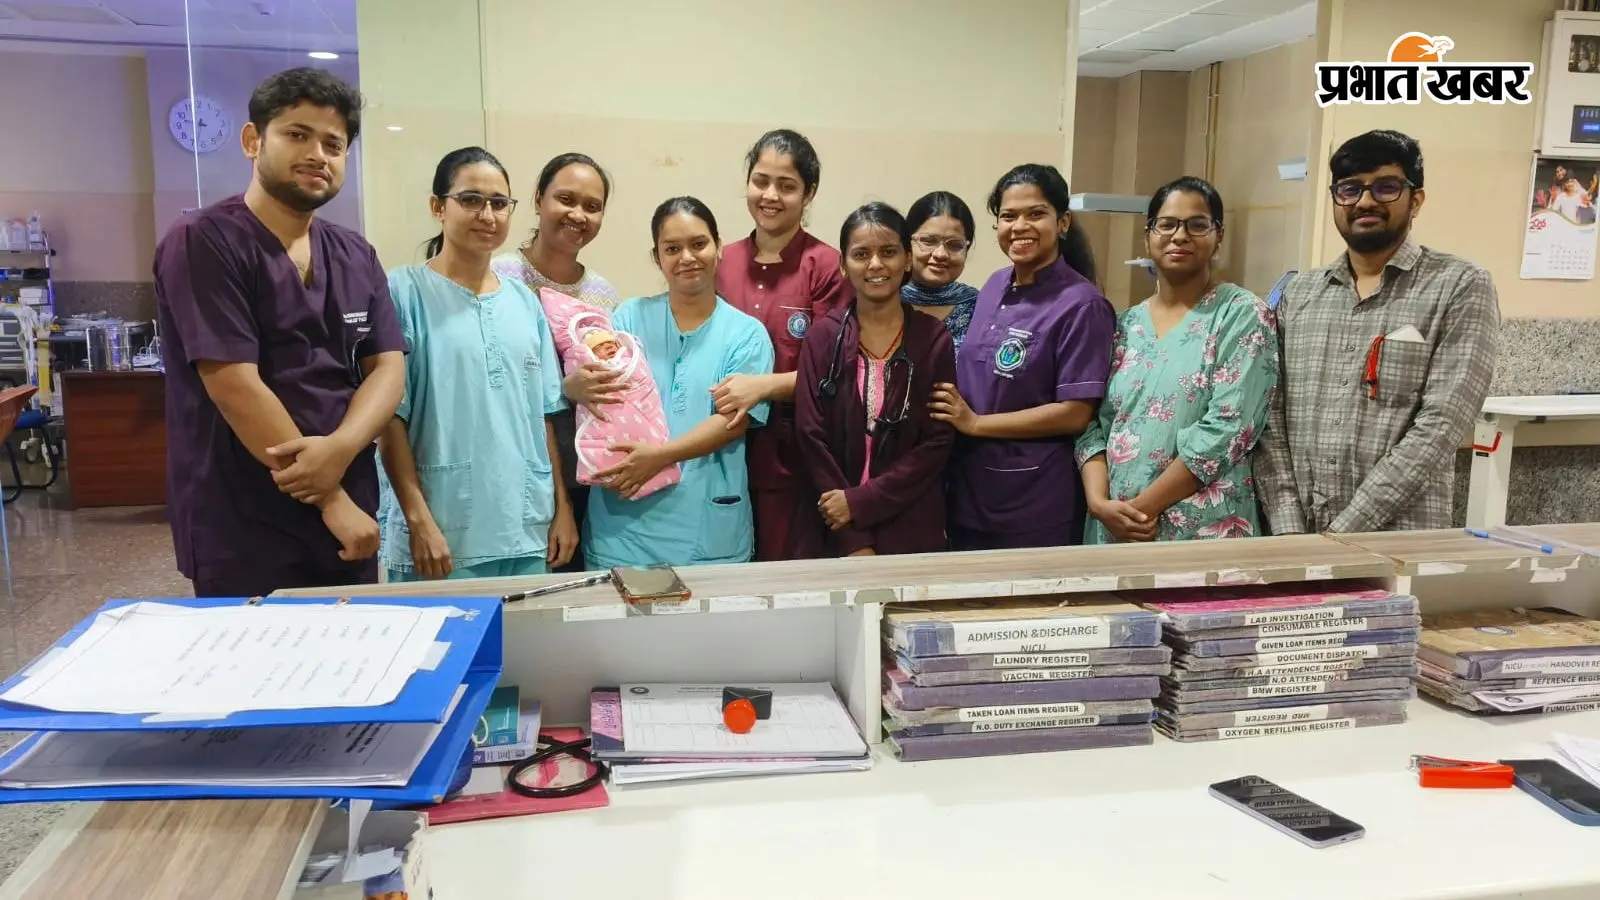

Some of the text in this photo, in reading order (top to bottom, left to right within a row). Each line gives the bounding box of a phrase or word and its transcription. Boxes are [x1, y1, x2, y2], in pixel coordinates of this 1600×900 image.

[1250, 611, 1335, 624] LAB INVESTIGATION
[1262, 616, 1364, 634] CONSUMABLE REGISTER
[968, 625, 1098, 643] ADMISSION &DISCHARGE
[1019, 643, 1046, 653] NICU
[1261, 640, 1284, 650] GIVEN
[1285, 639, 1304, 648] LOAN
[1305, 638, 1327, 647] ITEMS
[994, 655, 1088, 665] LAUNDRY REGISTER
[1277, 649, 1368, 662] DOCUMENT DISPATCH
[1265, 665, 1321, 676] ATTENDENCE
[1505, 661, 1523, 670] NICU
[1550, 660, 1590, 669] HANDOVER
[1003, 669, 1095, 681] VACCINE REGISTER
[1272, 676, 1287, 684] N.O
[1532, 675, 1577, 685] REFERENCE
[1252, 683, 1318, 694] BMW REGISTER
[967, 704, 1080, 718] TAKEN LOAN ITEMS REGISTER
[1545, 703, 1595, 713] FUMIGATION
[994, 721, 1014, 730] DUTY
[1015, 719, 1057, 729] EXCHANGE
[1058, 716, 1096, 726] REGISTER
[1245, 712, 1288, 723] REGISTER
[1225, 720, 1351, 738] OXYGEN REFILLING REGISTER
